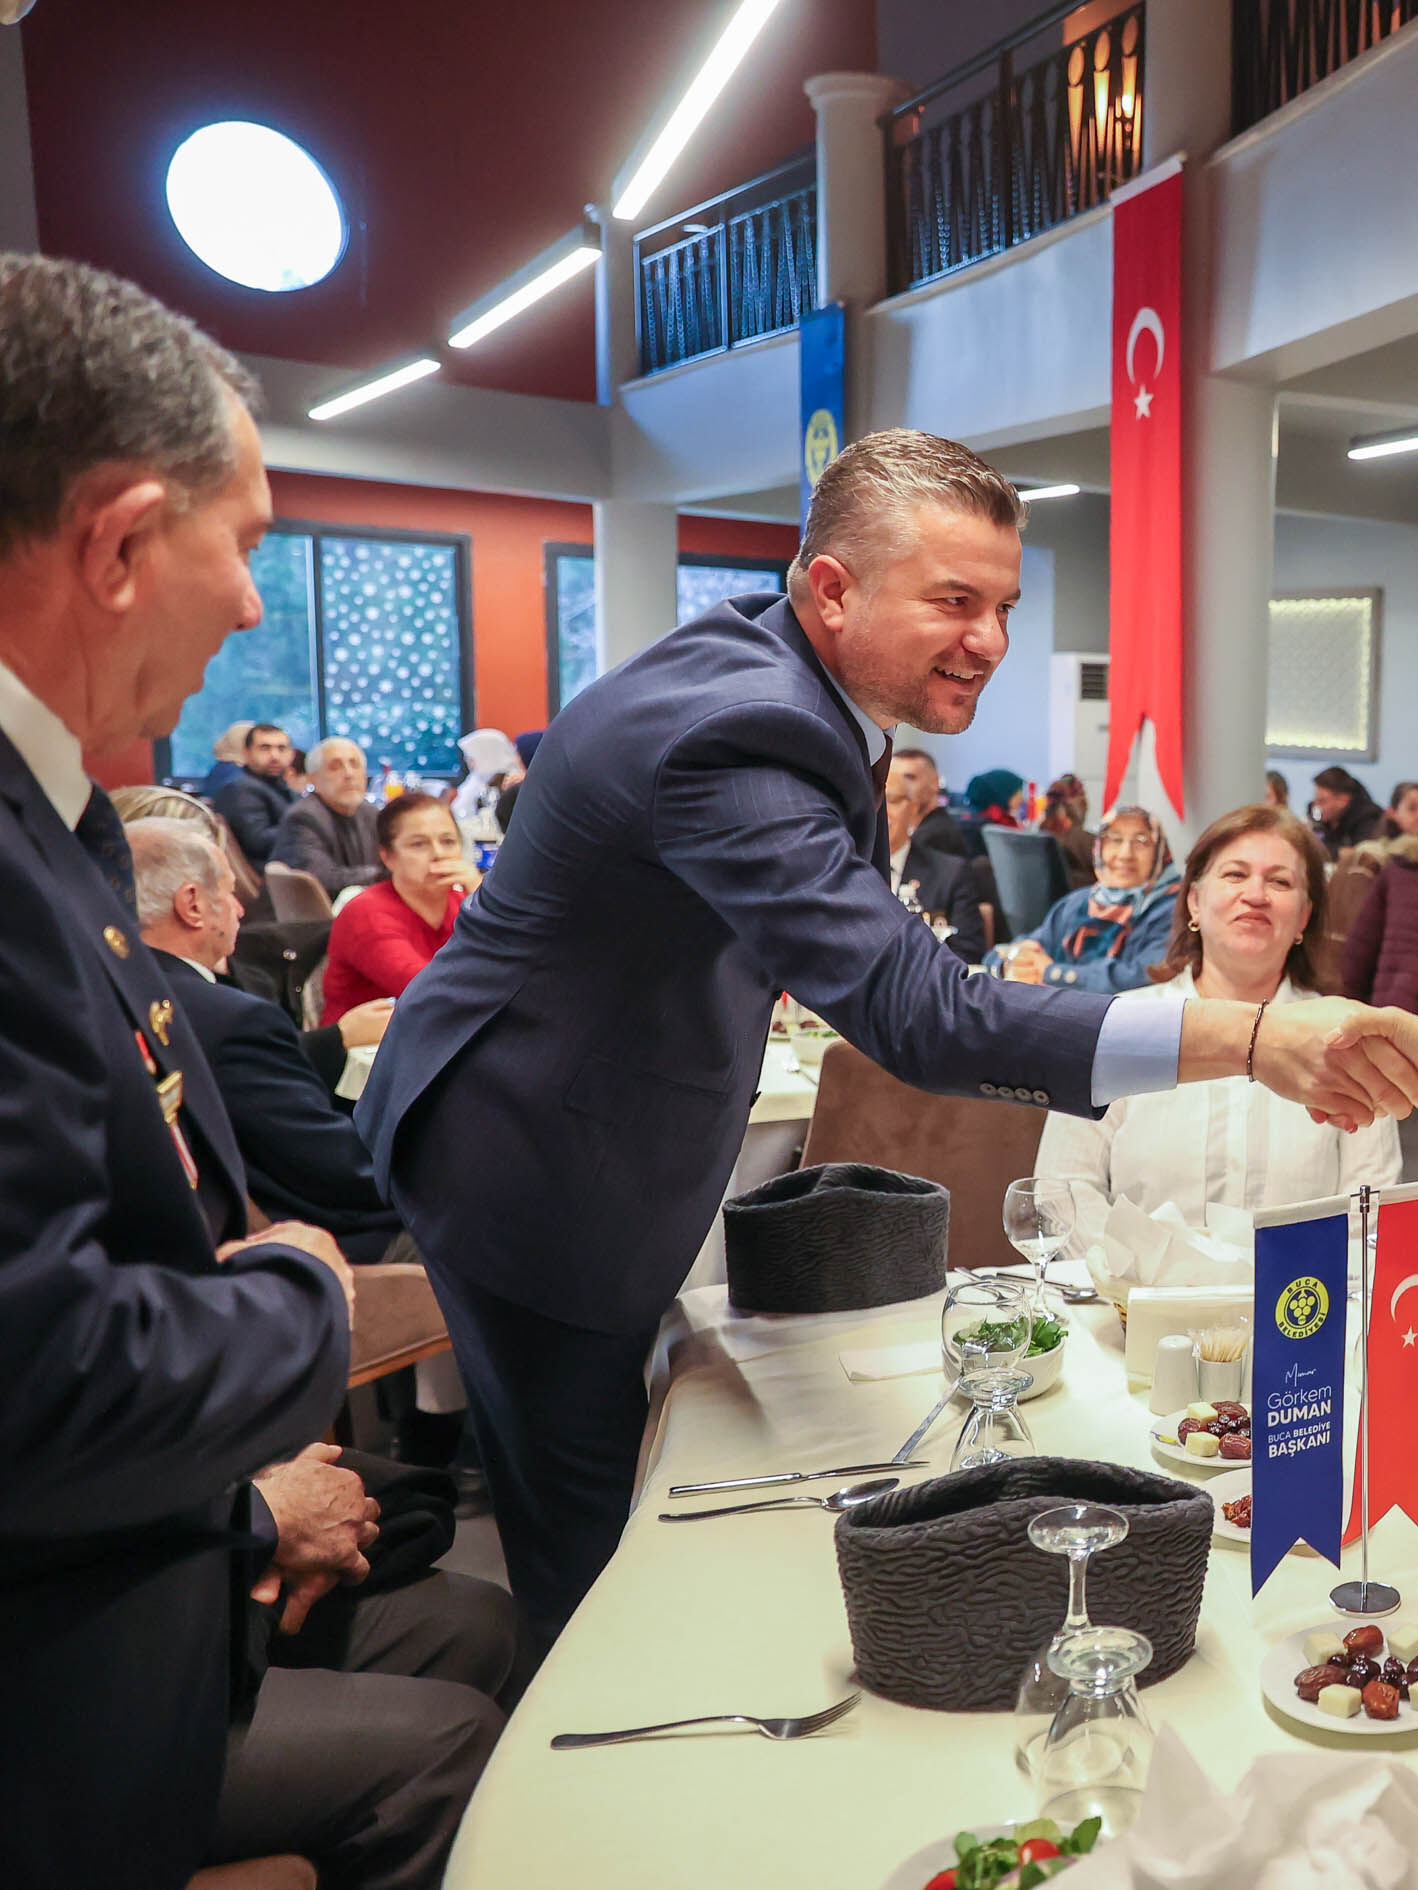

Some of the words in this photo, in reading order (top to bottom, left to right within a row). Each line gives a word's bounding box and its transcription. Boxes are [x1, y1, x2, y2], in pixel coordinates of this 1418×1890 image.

[1287, 1279, 1318, 1294] BUCA
[1267, 1386, 1332, 1409] Görkem
[1267, 1399, 1332, 1427] DUMAN
[1268, 1431, 1291, 1444] BUCA
[1293, 1421, 1331, 1438] BELEDİYE
[1268, 1430, 1331, 1458] BAŞKANI
